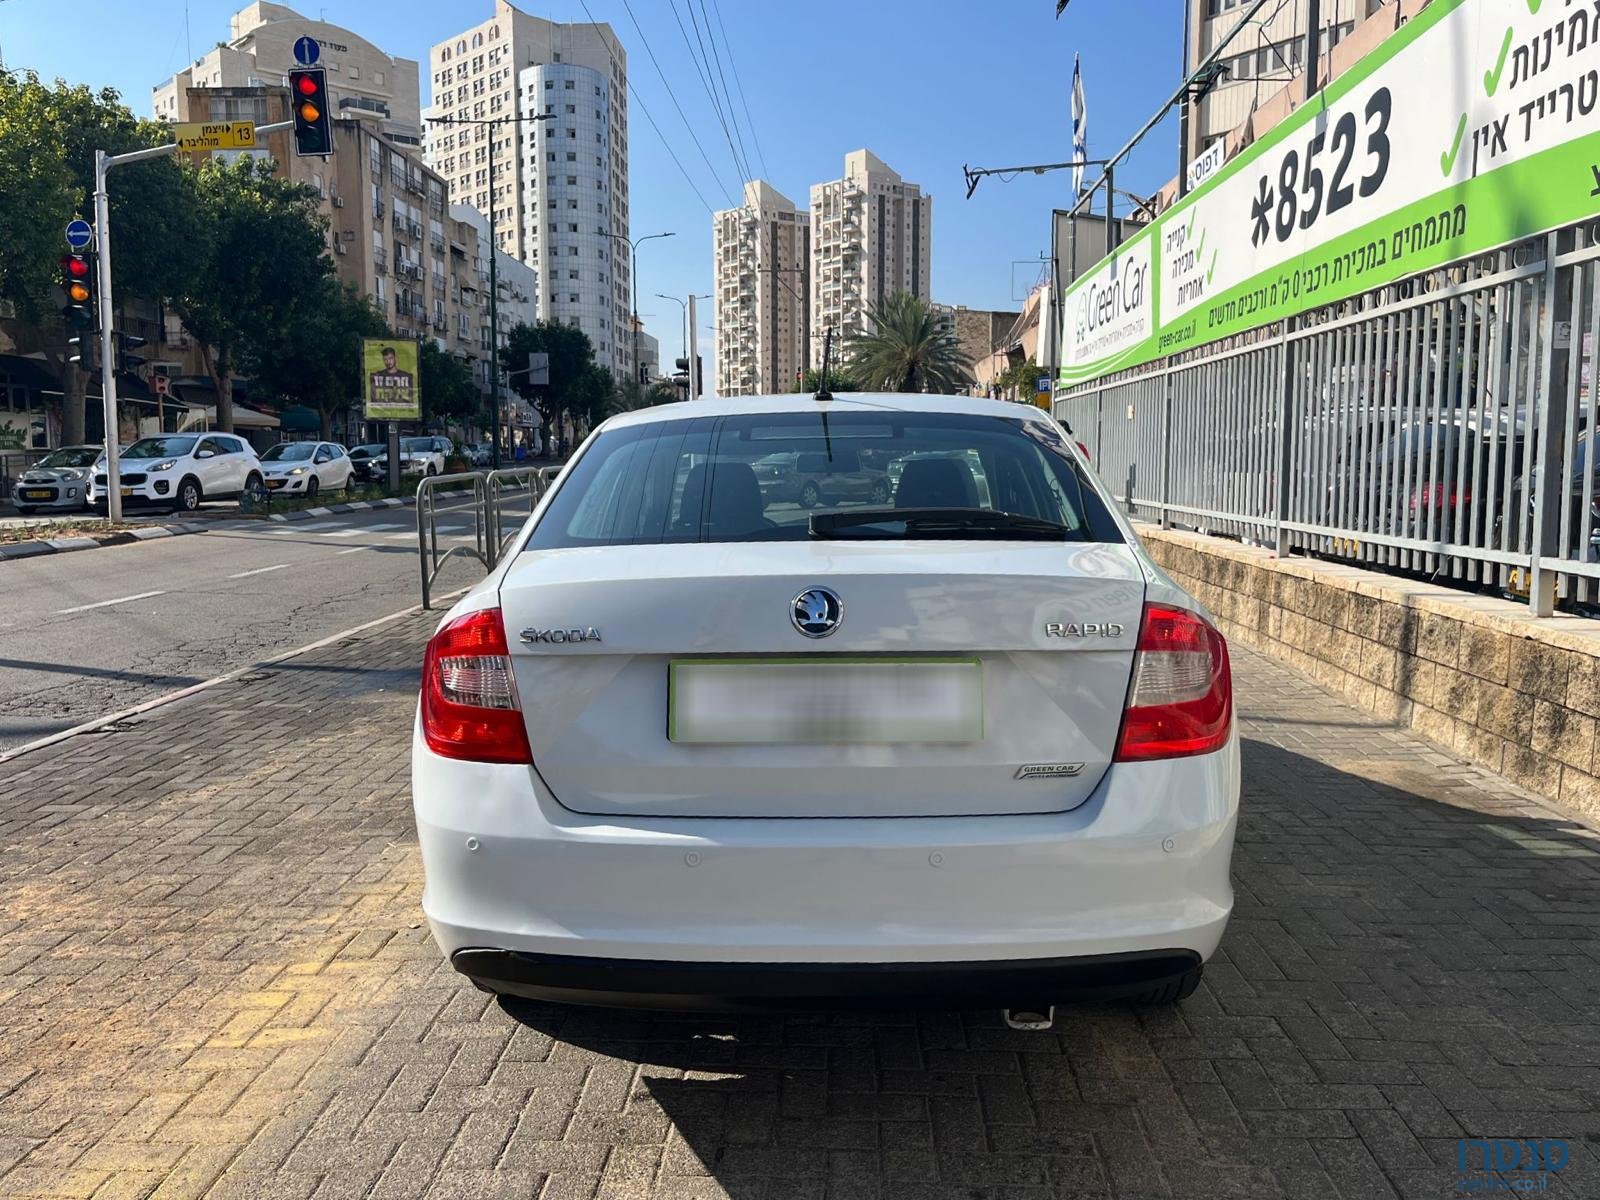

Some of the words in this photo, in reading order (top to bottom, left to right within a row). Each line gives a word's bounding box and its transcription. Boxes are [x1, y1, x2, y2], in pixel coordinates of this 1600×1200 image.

[1518, 69, 1598, 143] טרייד
[202, 125, 224, 136] ויצמן
[237, 127, 250, 141] 13
[1472, 113, 1509, 178] אין
[1195, 148, 1218, 180] דפוס
[1166, 225, 1186, 253] קנייה
[1391, 204, 1466, 260] מתמחים
[1172, 250, 1194, 279] מכירה
[1332, 239, 1386, 284] במכירת
[1177, 275, 1204, 306] אחריות
[1303, 263, 1328, 294] רכבי
[1088, 280, 1121, 332] Green
[1123, 256, 1147, 313] Car
[1238, 288, 1268, 317] ורכבים
[1208, 303, 1236, 328] חדשים
[519, 627, 601, 644] ŠKODA
[1045, 623, 1124, 638] RAPID
